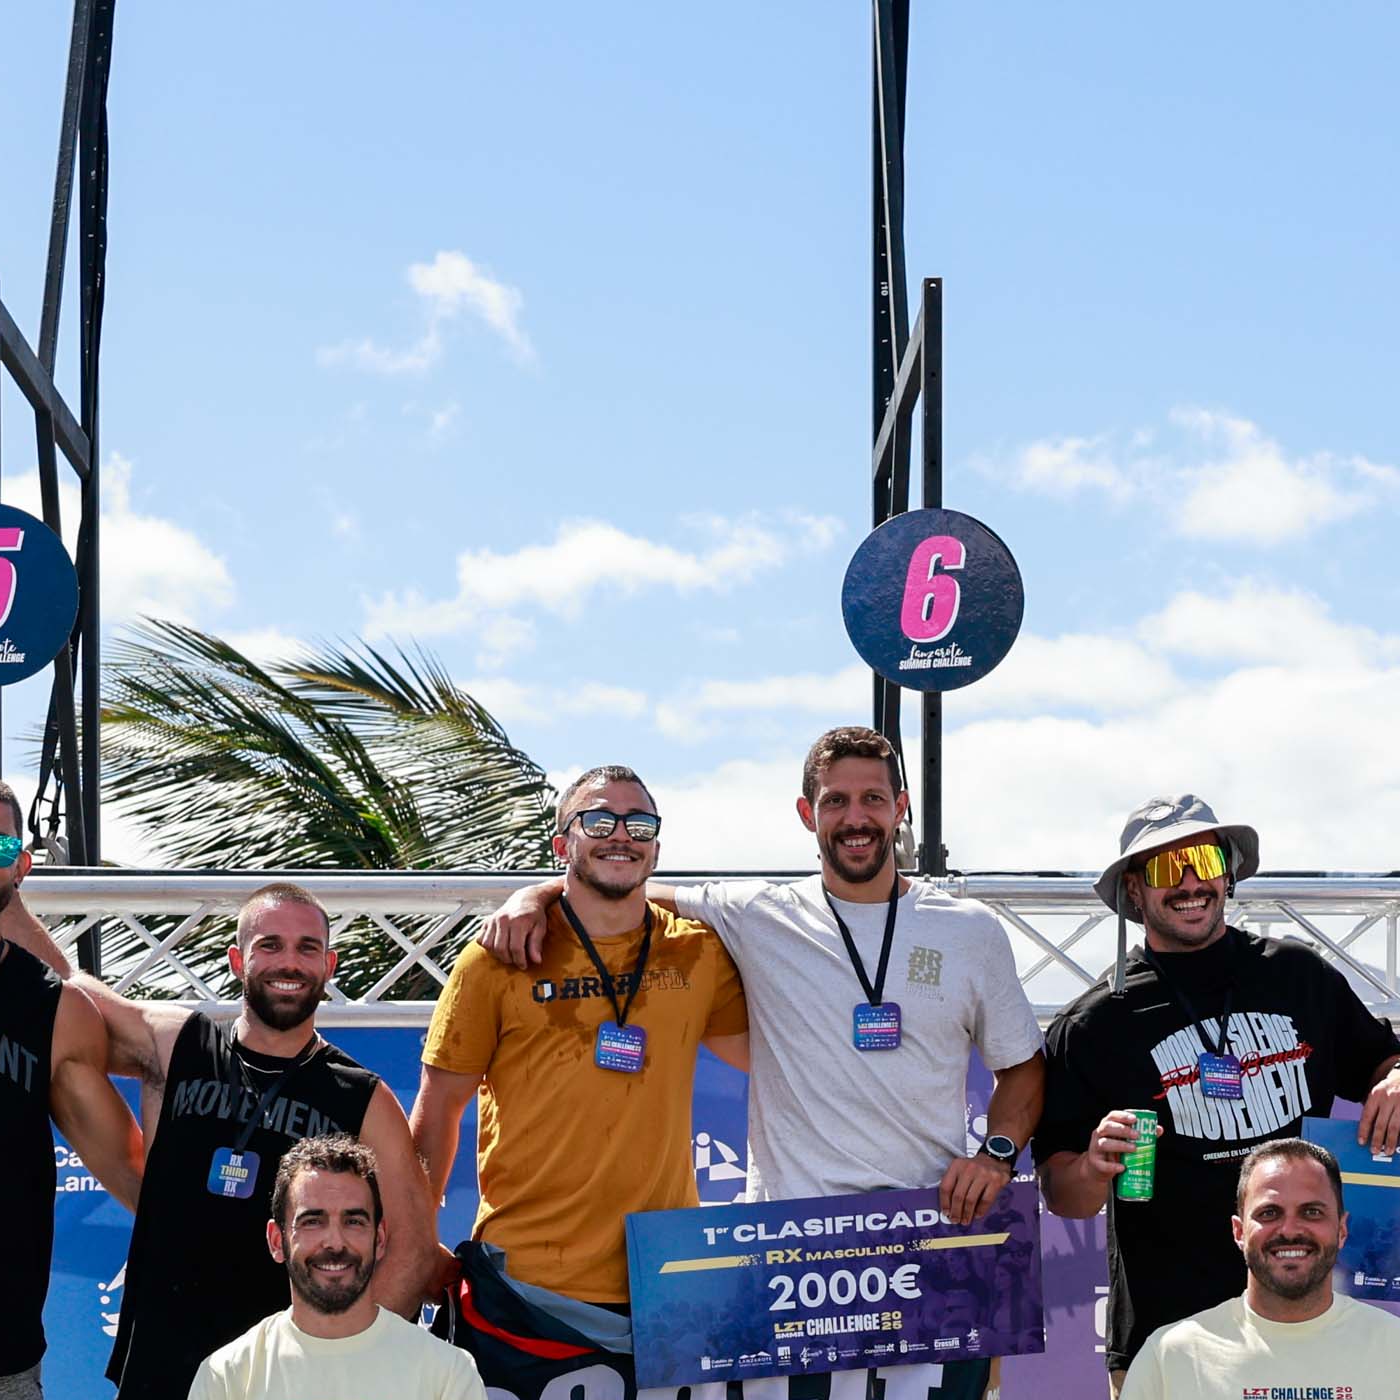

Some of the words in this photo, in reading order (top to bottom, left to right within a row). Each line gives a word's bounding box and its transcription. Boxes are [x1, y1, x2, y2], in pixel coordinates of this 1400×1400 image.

[900, 535, 966, 643] 6
[899, 659, 932, 670] SUMMER
[933, 656, 972, 668] CHALLENGE
[221, 1165, 249, 1179] THIRD
[766, 1248, 803, 1265] RX
[805, 1243, 905, 1262] MASCULINO
[768, 1263, 922, 1311] 2000€
[774, 1321, 806, 1333] LZT
[806, 1313, 880, 1336] CHALLENGE
[881, 1311, 902, 1321] 20
[775, 1331, 804, 1340] SMMR
[881, 1320, 903, 1331] 25
[1271, 1387, 1334, 1400] CHALLENGE
